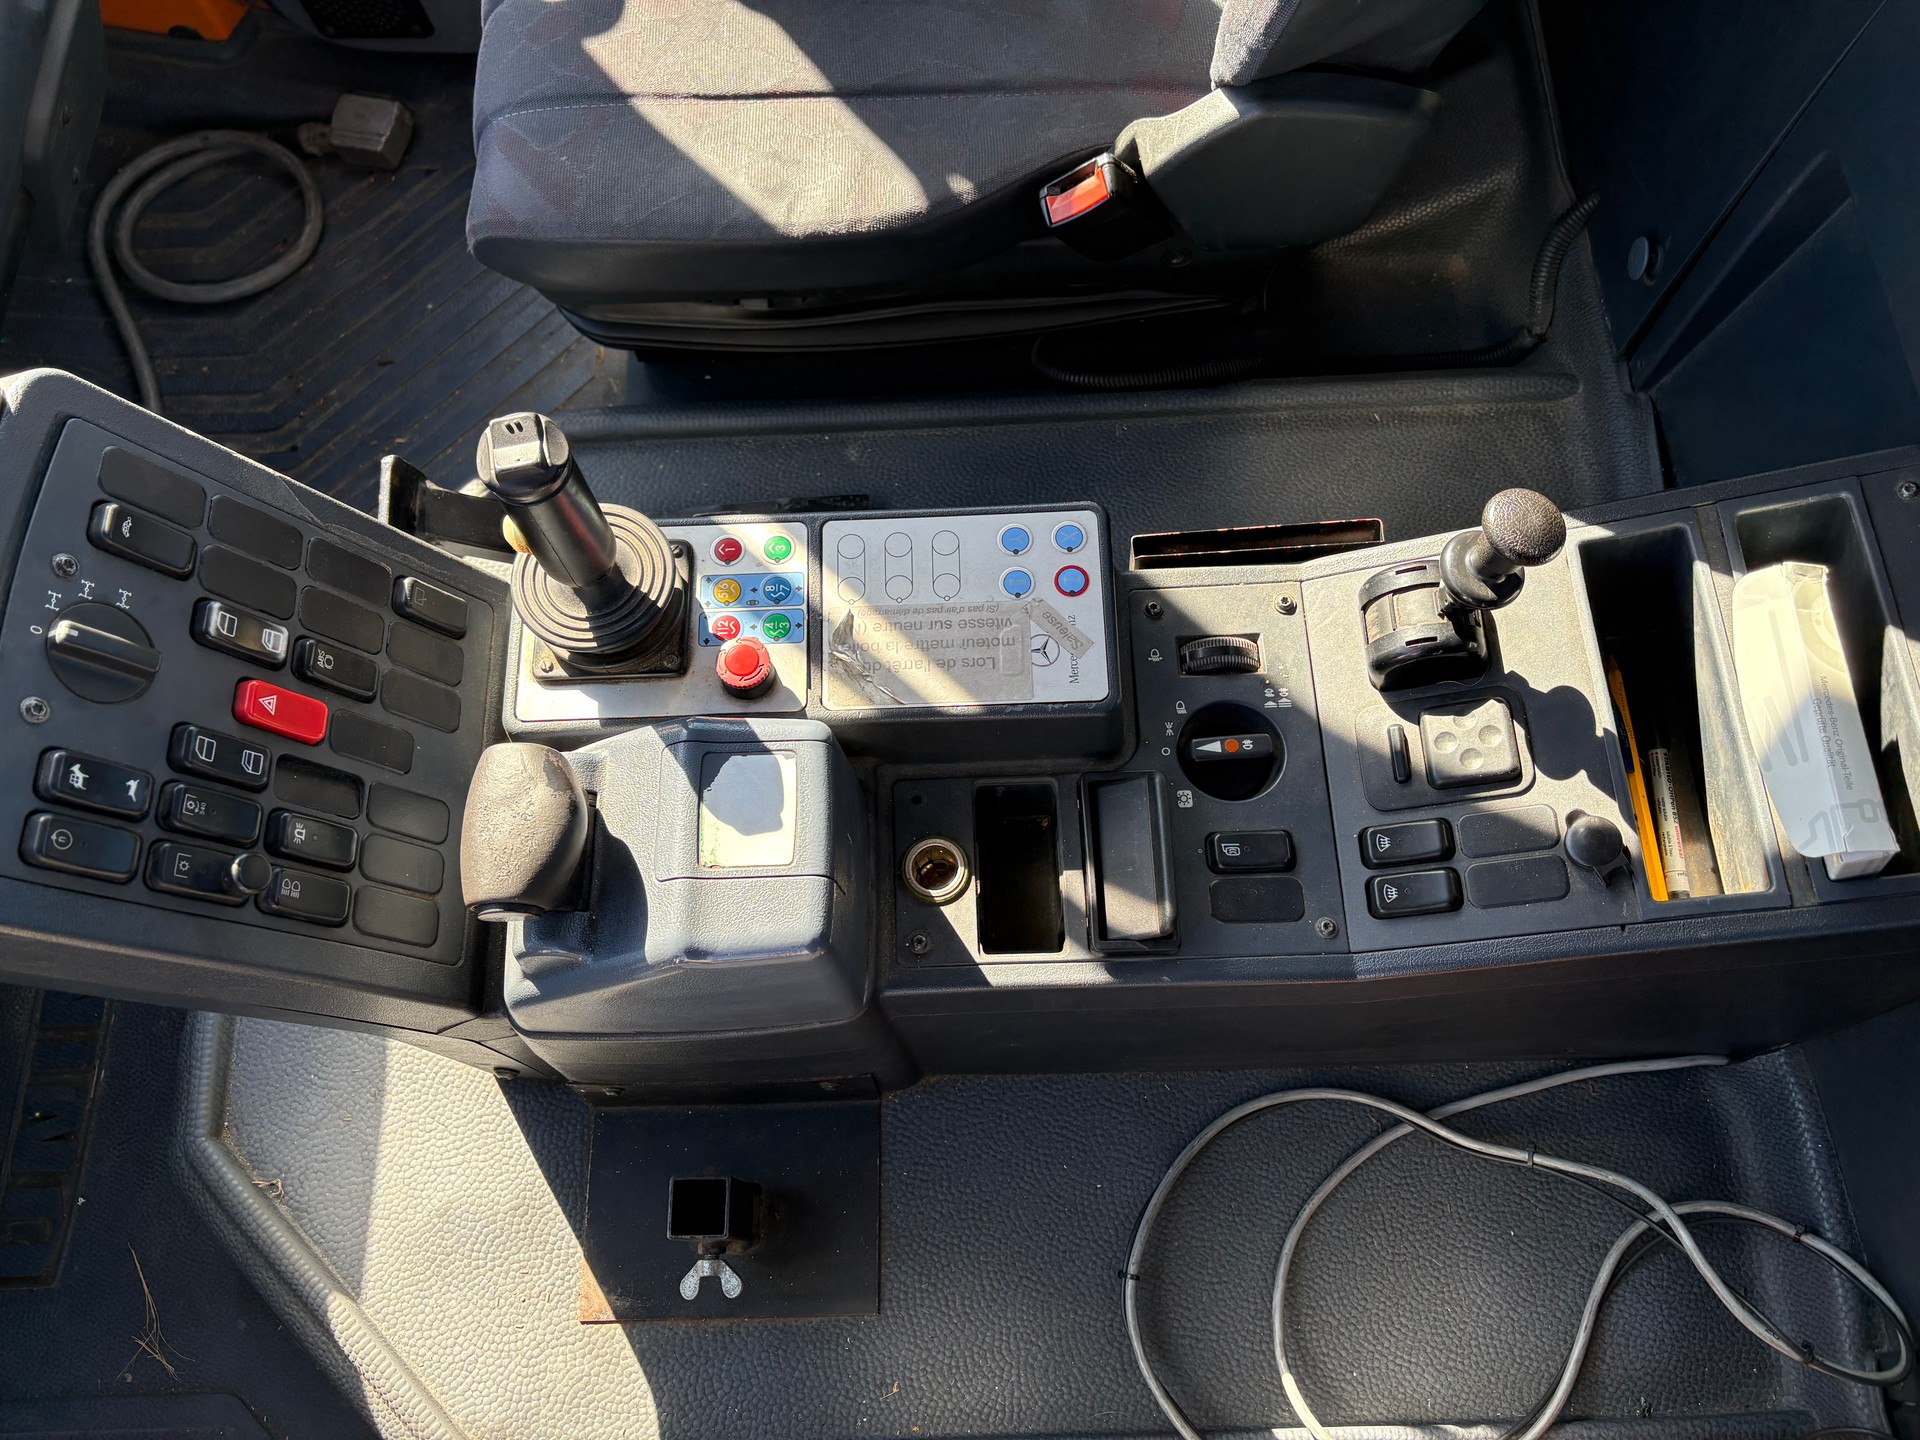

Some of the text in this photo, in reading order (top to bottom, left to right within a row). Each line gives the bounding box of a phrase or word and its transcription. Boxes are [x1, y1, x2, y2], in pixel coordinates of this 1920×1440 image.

[911, 607, 923, 616] de
[926, 605, 944, 614] pas
[945, 606, 965, 616] d'air
[967, 604, 985, 613] pas
[986, 604, 1000, 614] (Si
[872, 620, 923, 633] neutre
[927, 619, 953, 630] sur
[957, 617, 1013, 631] vitesse
[1043, 611, 1084, 650] Saleuse
[886, 641, 898, 654] la
[904, 638, 955, 653] mettre
[960, 635, 1016, 649] moteur
[317, 648, 326, 669] ABS
[862, 656, 995, 675] Lors de l'arrêt du
[1812, 698, 1837, 768] Geprüfte Qualität
[1819, 675, 1854, 791] Mercedes-Benz Original-Teile
